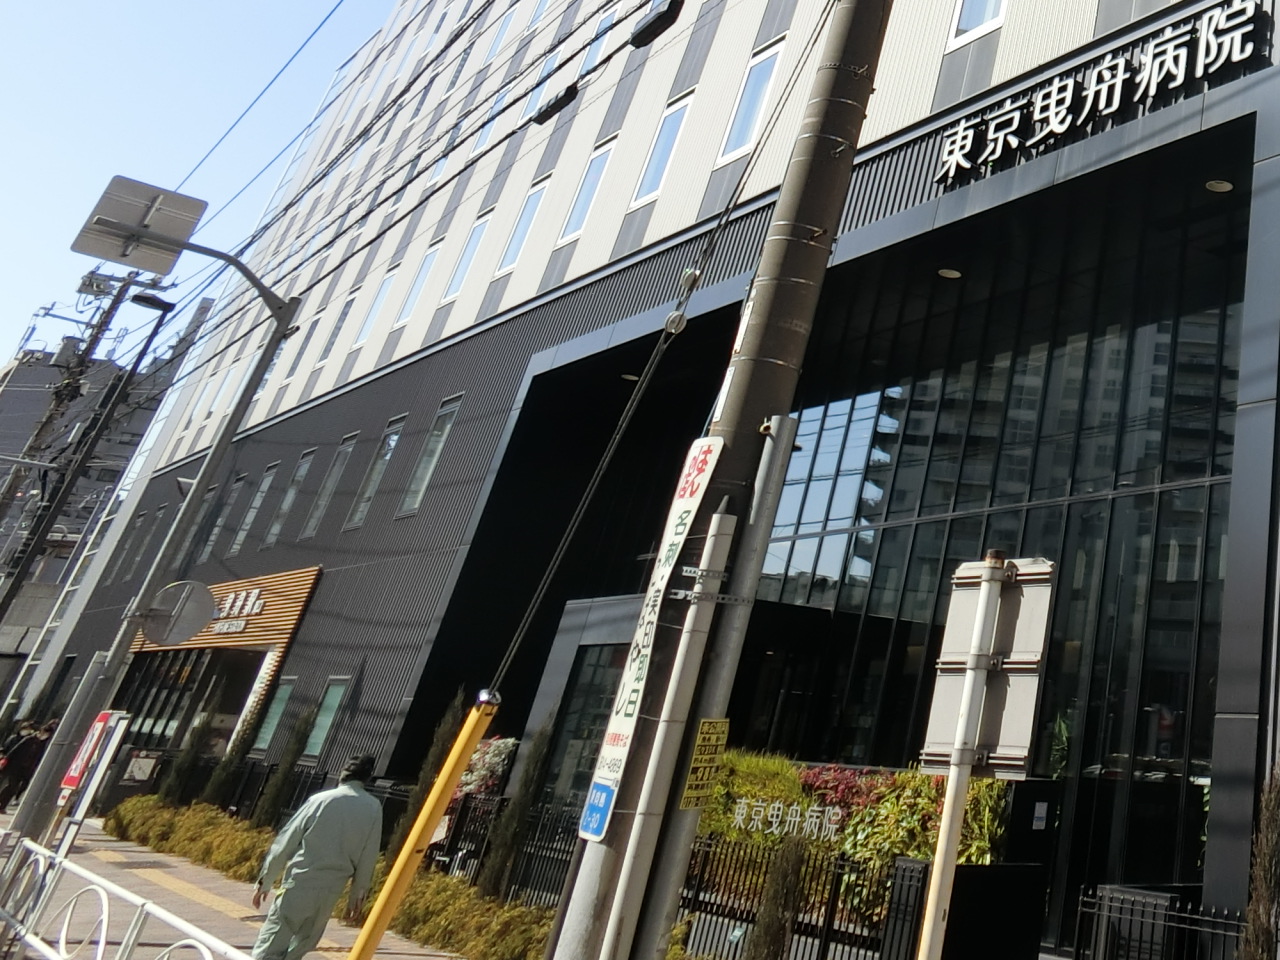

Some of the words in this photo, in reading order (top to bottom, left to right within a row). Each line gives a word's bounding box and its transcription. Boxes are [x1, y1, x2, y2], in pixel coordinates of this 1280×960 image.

[731, 796, 842, 841] 東京曳舟病院
